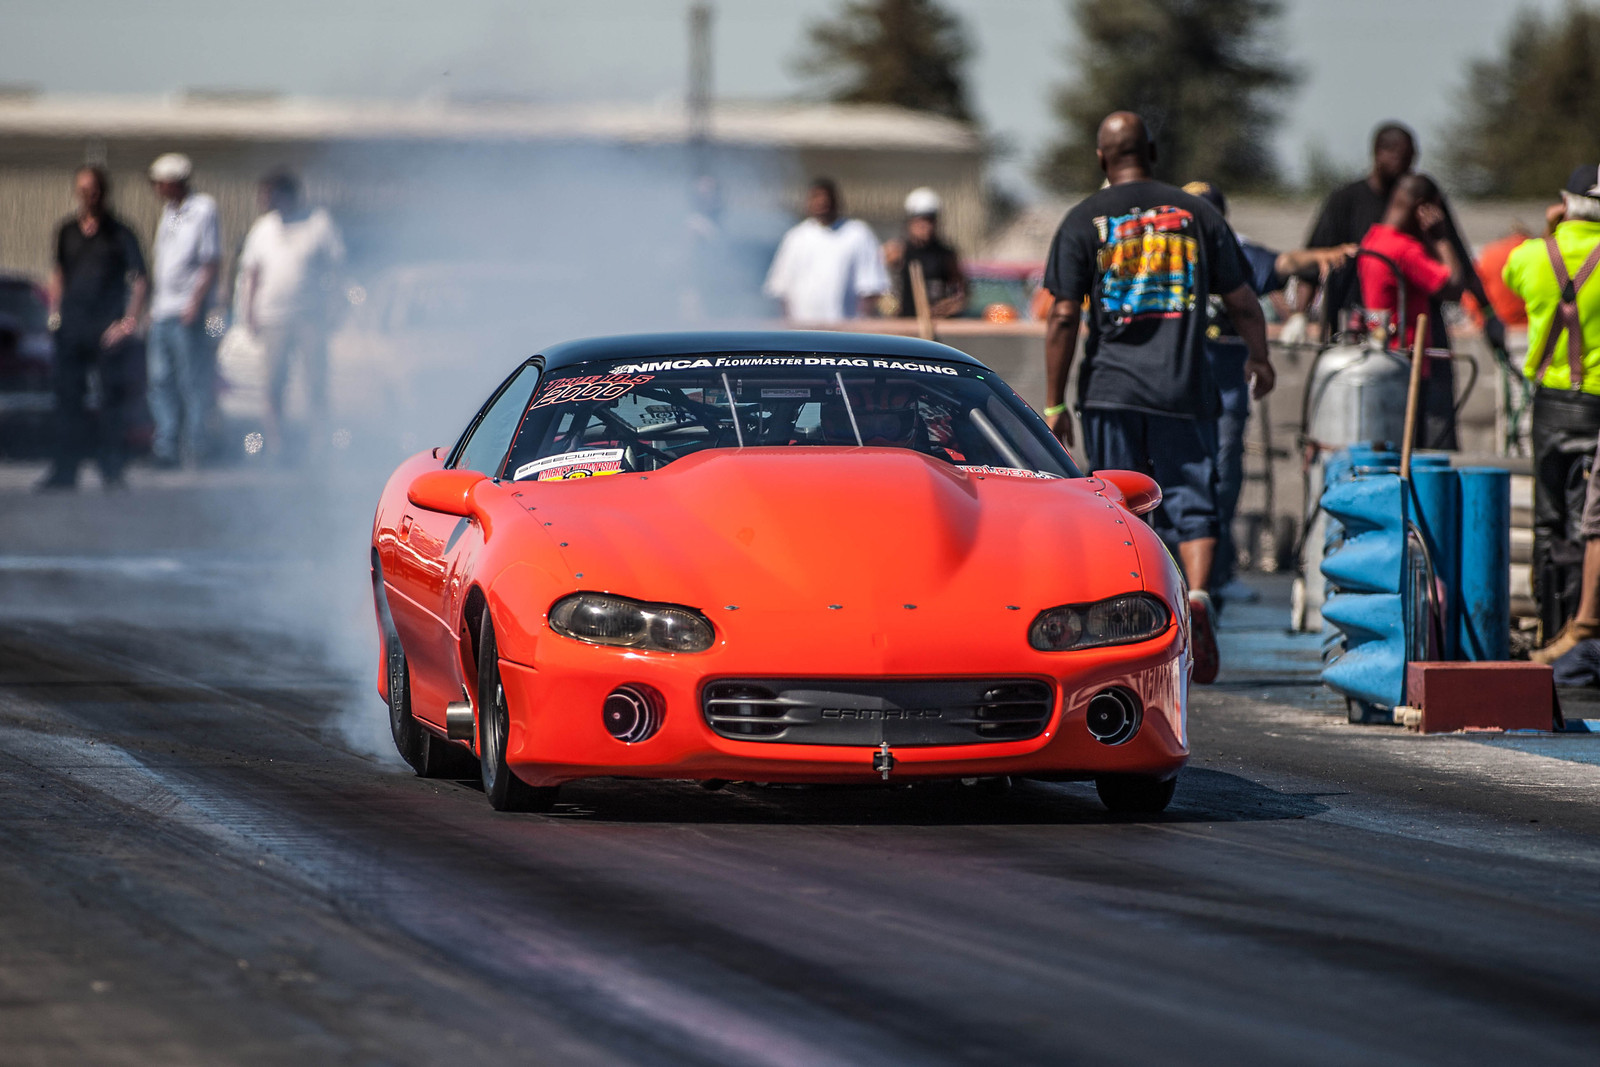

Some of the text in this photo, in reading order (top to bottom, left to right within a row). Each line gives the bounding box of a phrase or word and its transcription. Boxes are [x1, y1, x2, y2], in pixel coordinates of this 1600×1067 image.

[626, 357, 959, 376] NMCA FLOWMASTER DRAG RACING
[529, 381, 635, 410] 2000
[518, 451, 617, 474] SPEEDWIRE
[538, 465, 573, 480] MICKEY
[572, 460, 622, 473] THOMPSON
[821, 708, 943, 720] CAMARO
